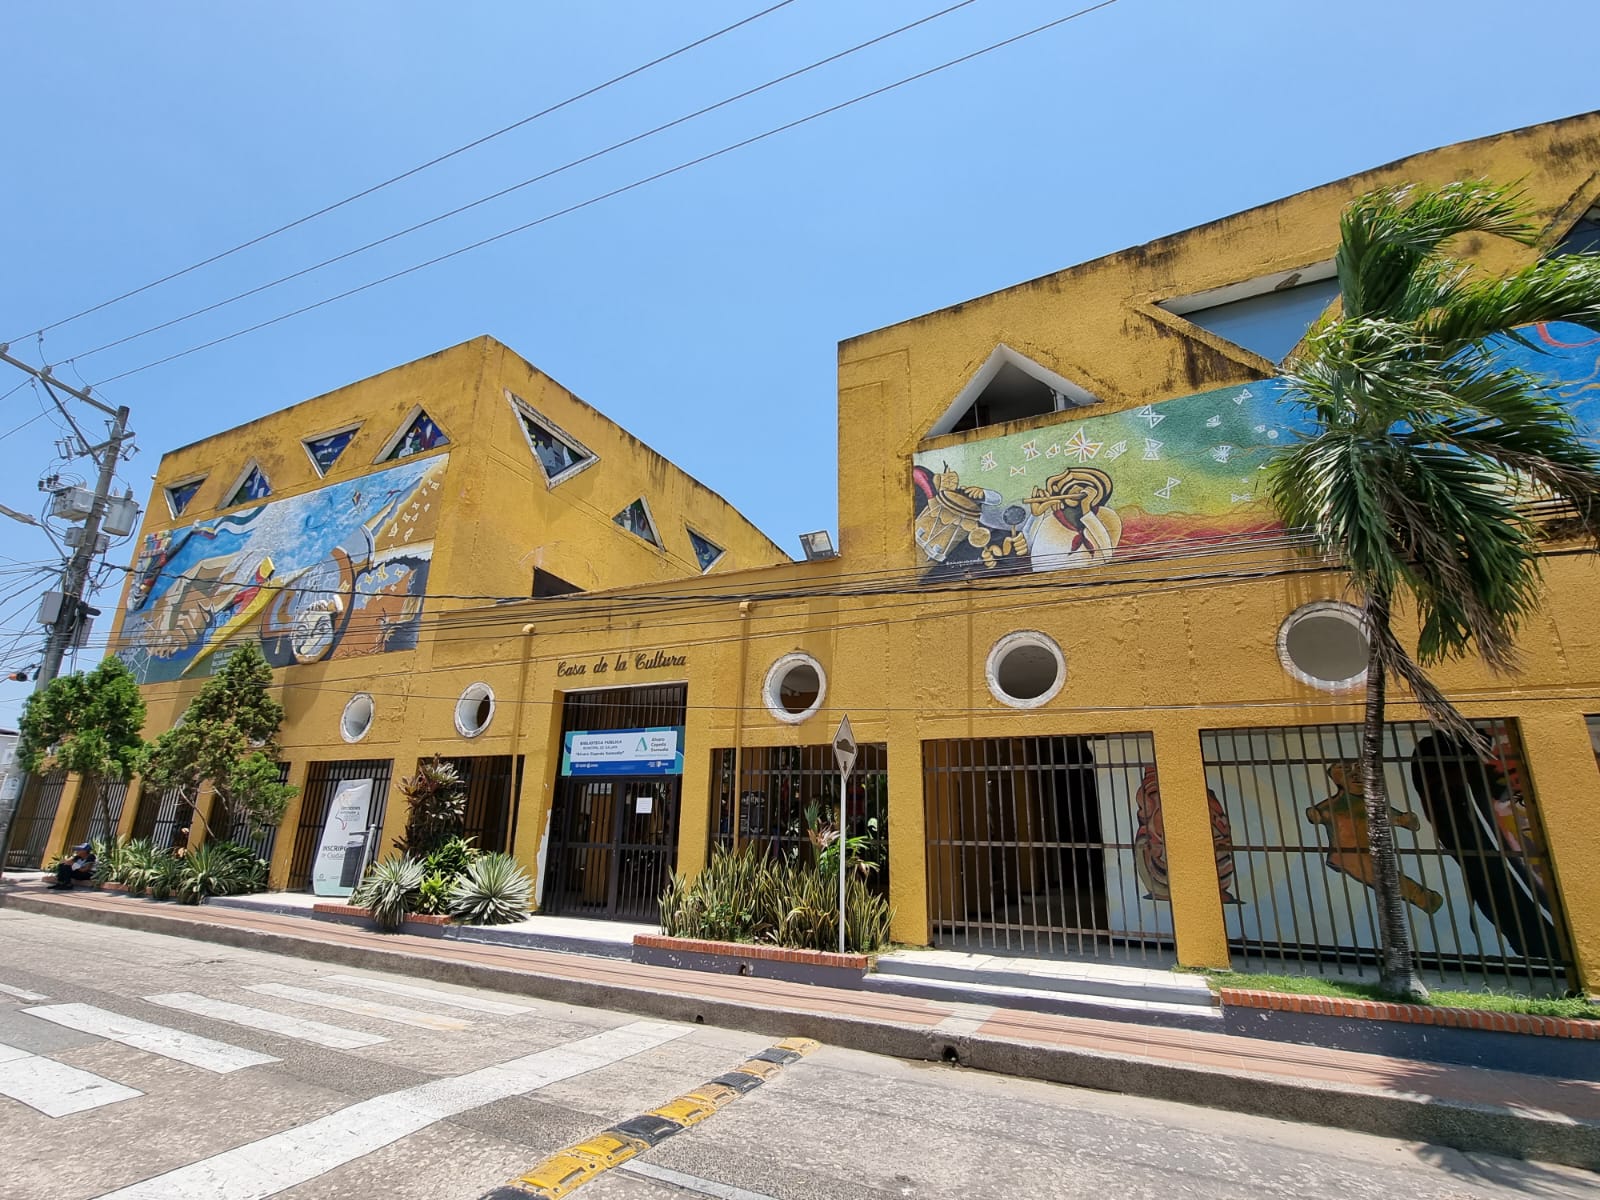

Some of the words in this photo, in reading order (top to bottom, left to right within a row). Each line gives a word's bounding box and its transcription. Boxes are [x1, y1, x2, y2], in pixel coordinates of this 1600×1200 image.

[557, 661, 586, 677] Casa
[594, 656, 608, 674] de
[615, 655, 627, 671] la
[636, 650, 686, 670] Cultura
